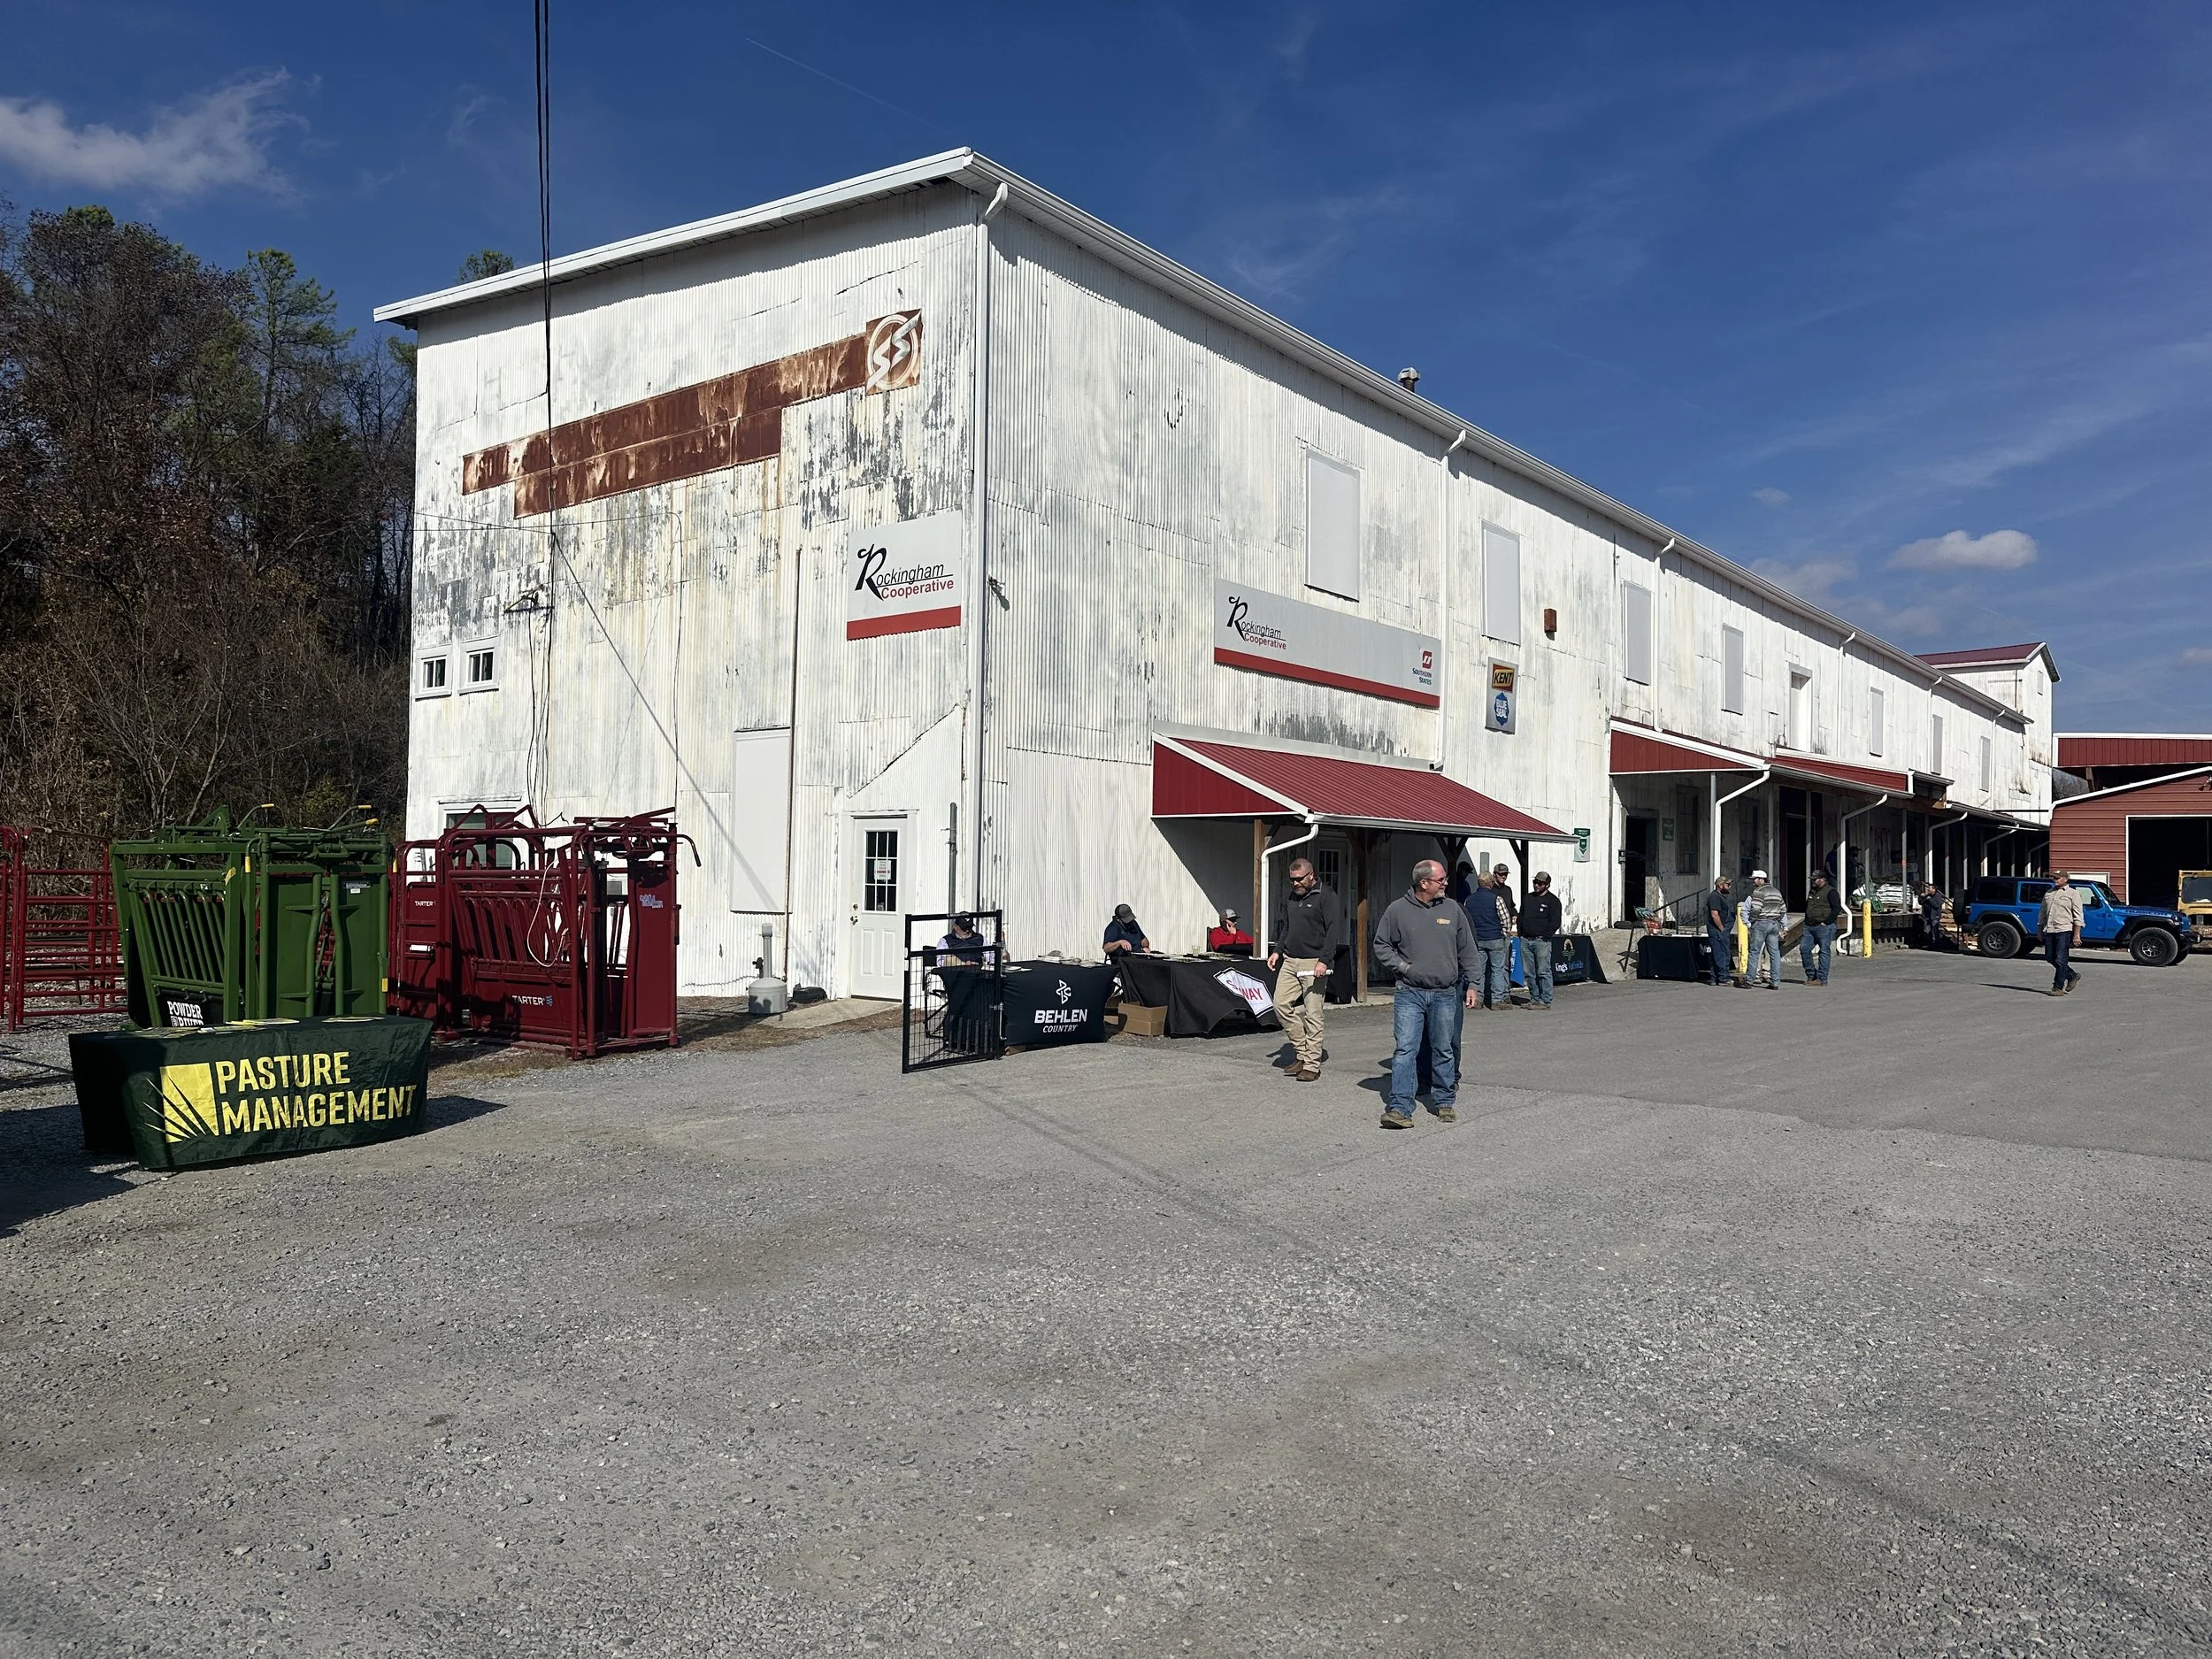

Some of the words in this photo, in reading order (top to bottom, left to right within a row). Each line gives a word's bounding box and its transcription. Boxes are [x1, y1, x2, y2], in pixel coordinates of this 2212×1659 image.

[855, 543, 944, 602] Rockingham
[881, 580, 954, 599] Cooperative
[1226, 596, 1281, 642] Rockingham
[1245, 632, 1286, 650] Cooperative
[1494, 672, 1513, 685] KENT
[512, 995, 544, 1006] TARTER
[166, 1001, 204, 1019] POWDER
[1034, 1009, 1087, 1024] BEHLEN
[1042, 1025, 1077, 1033] COUNTRY
[215, 1051, 350, 1094] PASTURE
[221, 1084, 417, 1135] MANAGEMENT
